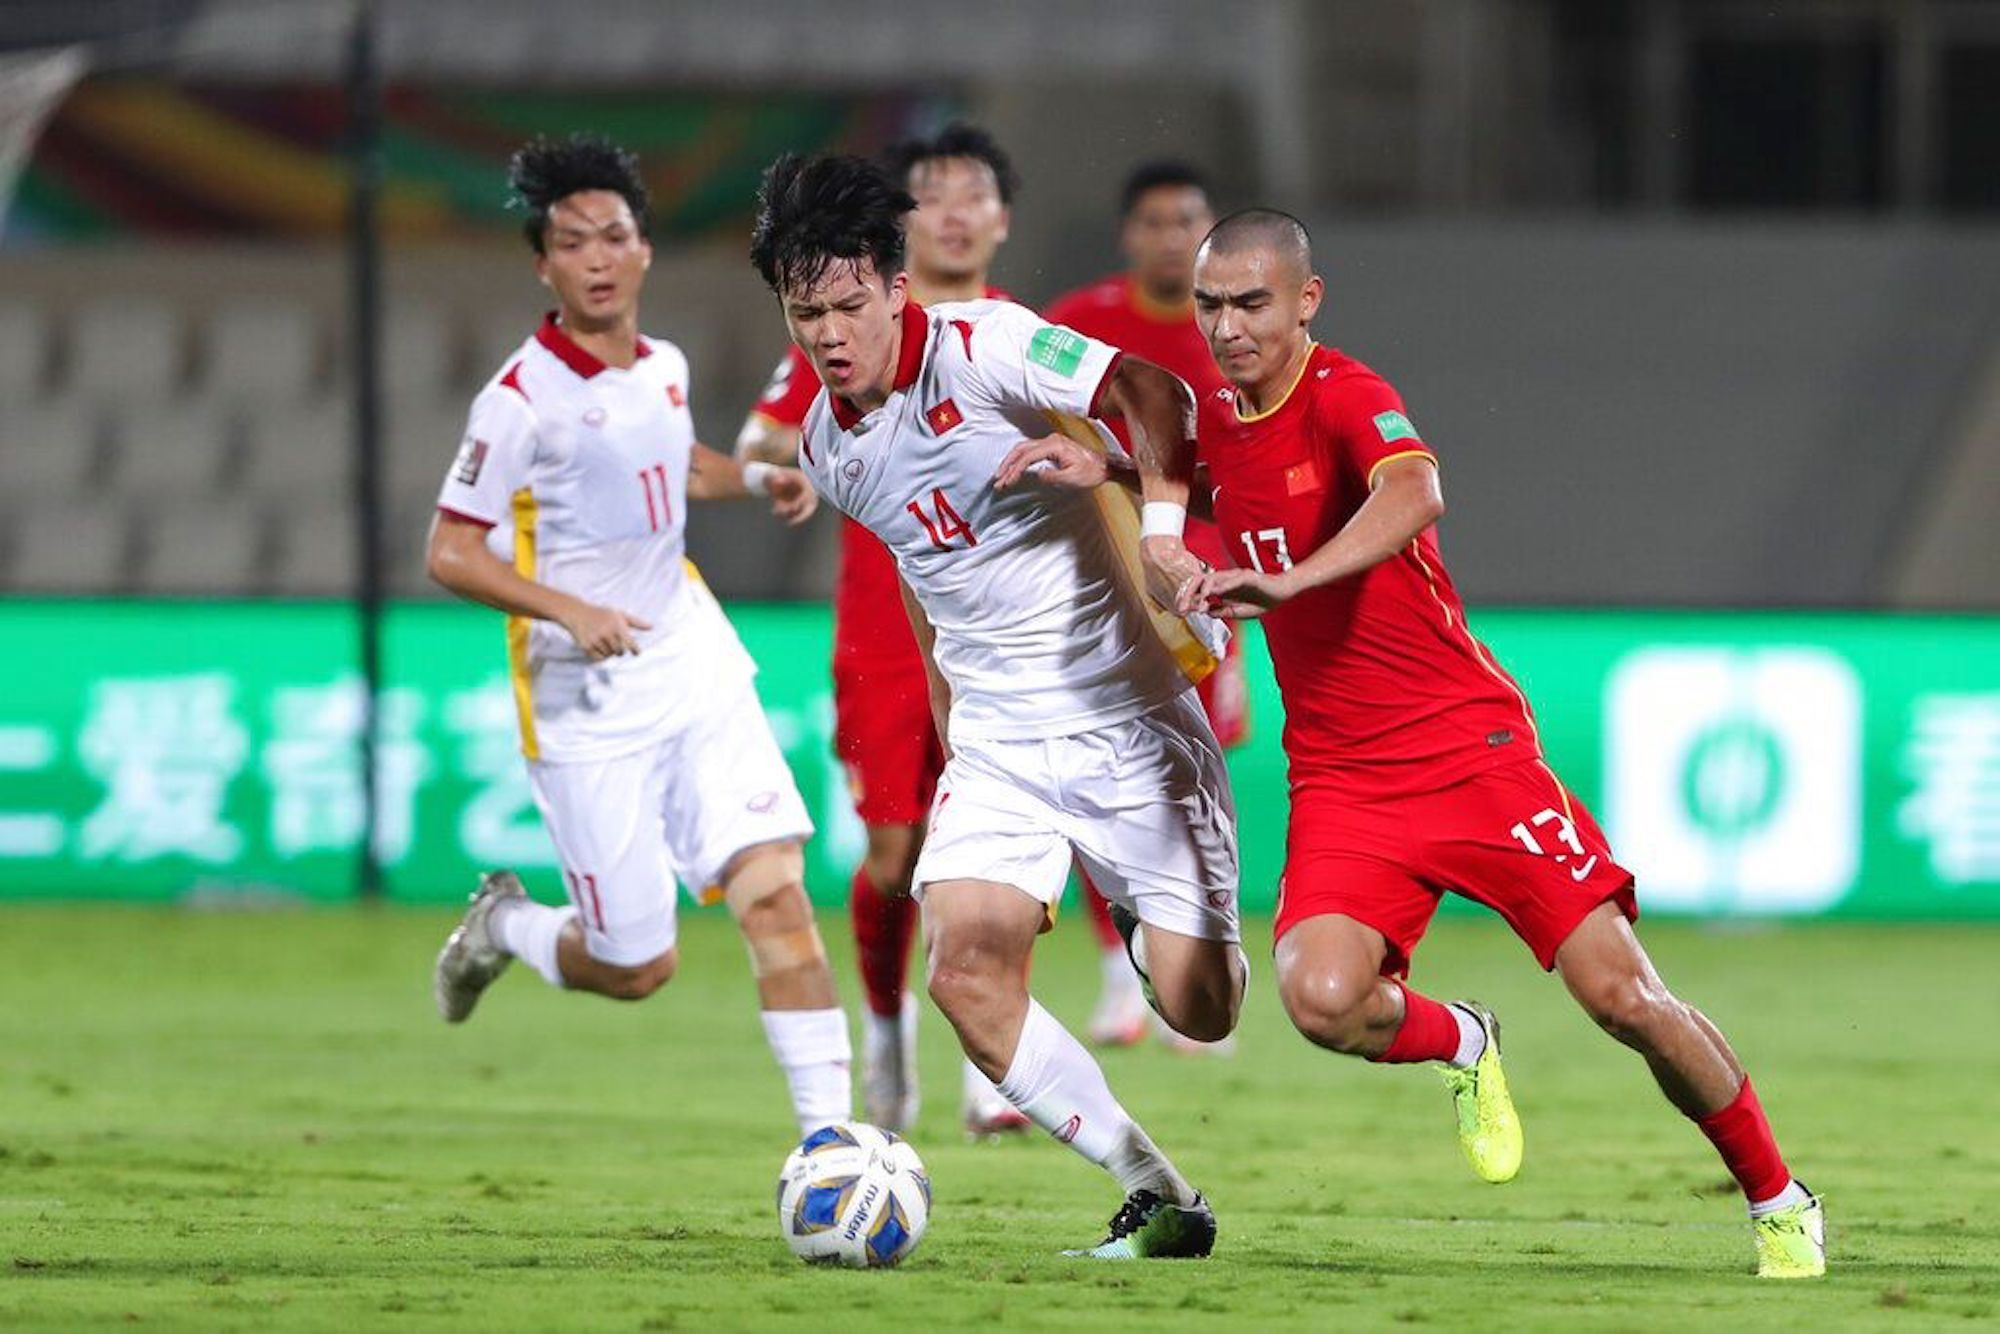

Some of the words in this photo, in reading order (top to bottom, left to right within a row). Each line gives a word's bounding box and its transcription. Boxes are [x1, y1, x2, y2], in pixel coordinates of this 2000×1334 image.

[638, 465, 673, 533] 11
[906, 487, 977, 552] 14
[567, 869, 608, 934] 11
[844, 1184, 880, 1241] molten
